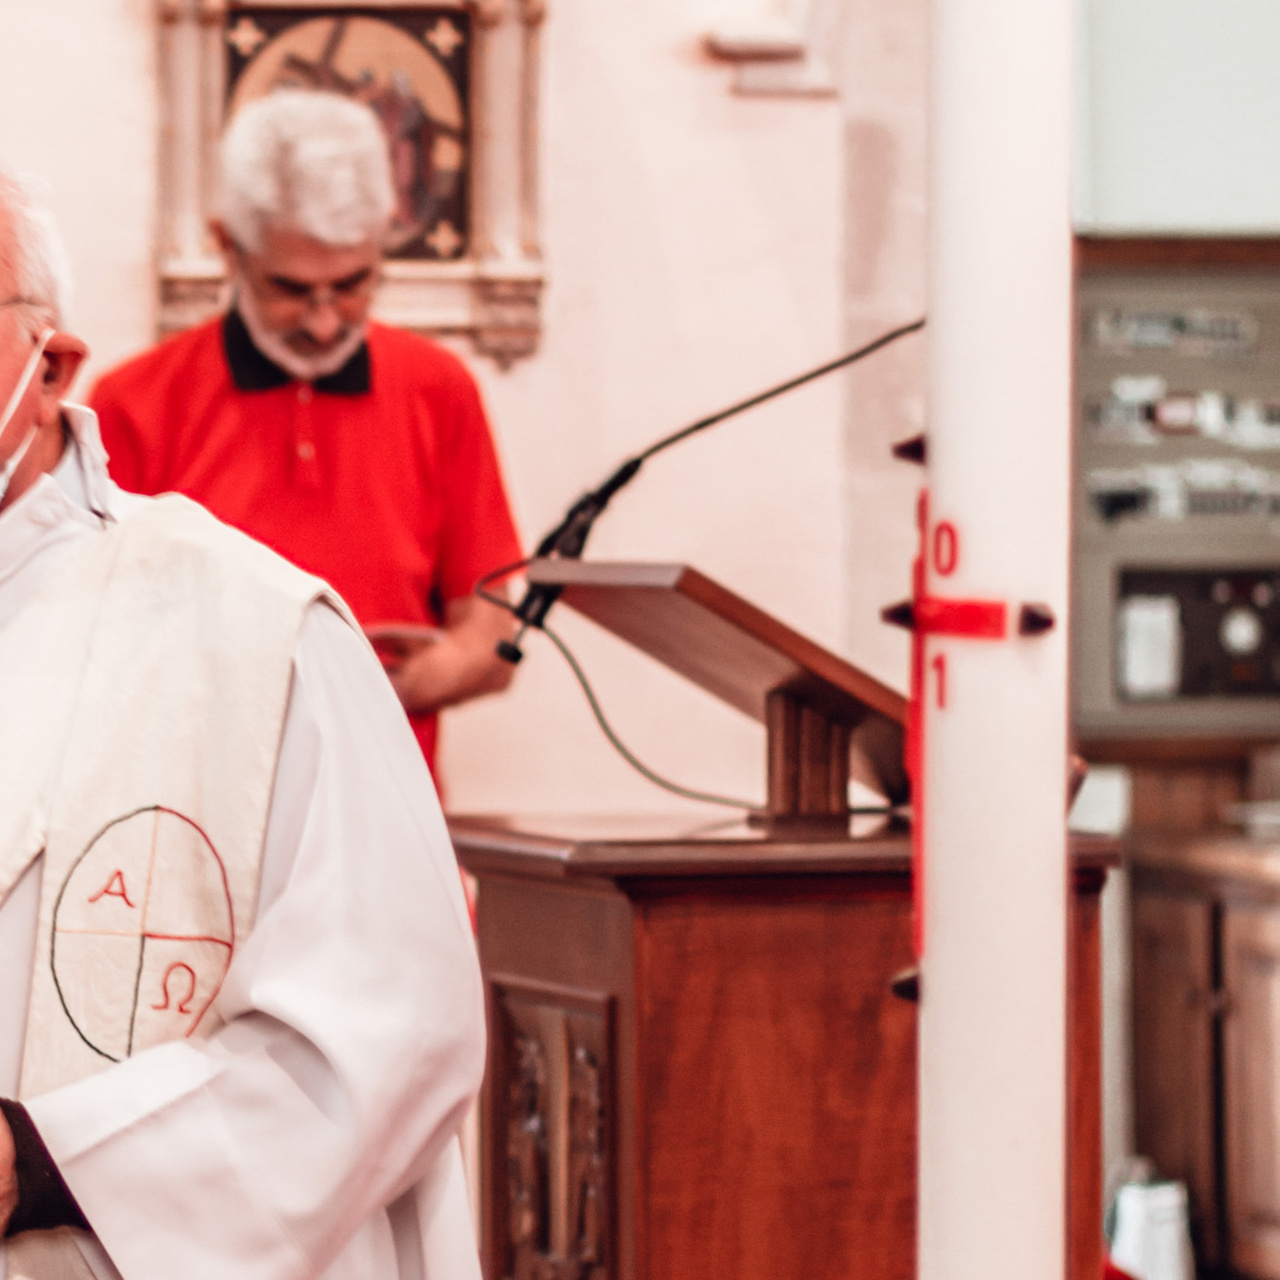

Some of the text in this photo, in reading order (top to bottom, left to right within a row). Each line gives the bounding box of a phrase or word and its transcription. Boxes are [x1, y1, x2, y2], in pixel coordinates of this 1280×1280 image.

[934, 521, 958, 577] 0
[933, 651, 946, 710] 1
[150, 962, 196, 1014] Ω
